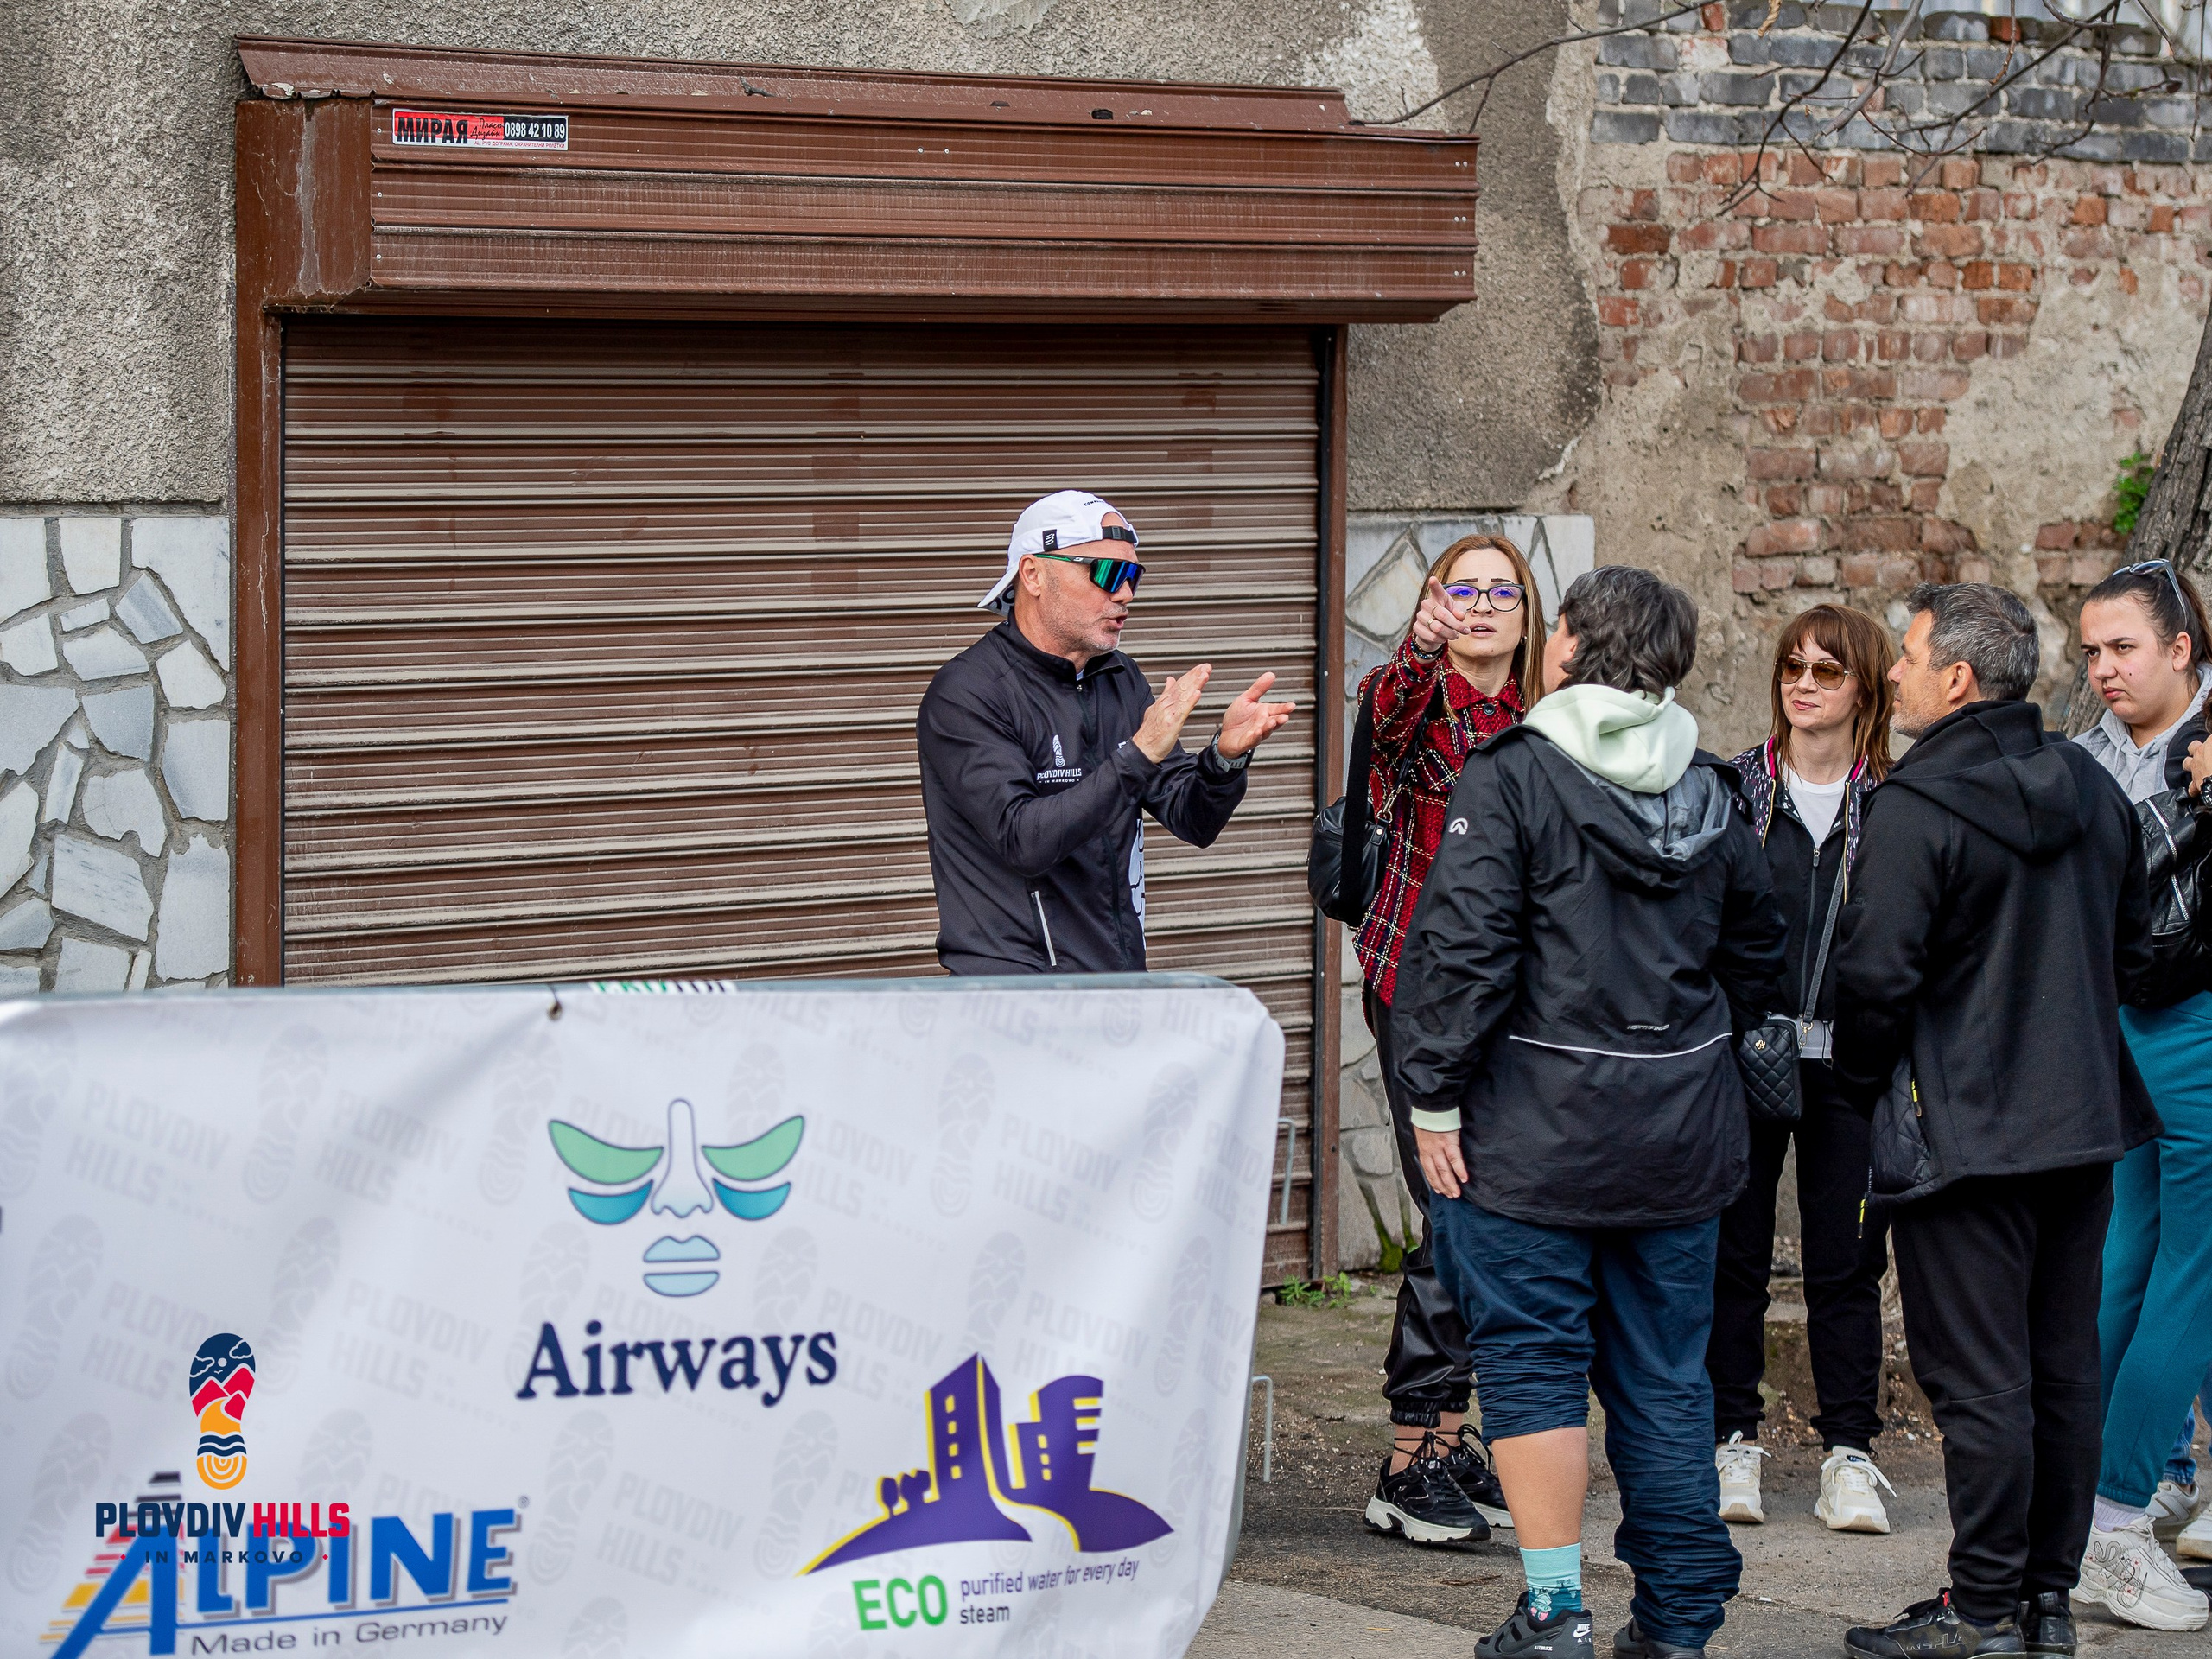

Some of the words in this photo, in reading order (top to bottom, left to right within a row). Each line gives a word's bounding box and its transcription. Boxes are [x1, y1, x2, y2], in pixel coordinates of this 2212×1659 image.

[397, 117, 469, 144] МИРАЯ
[505, 122, 526, 137] 0898
[528, 123, 539, 137] 42
[542, 123, 552, 138] 10
[554, 124, 565, 138] 89
[1065, 768, 1082, 777] HILLS
[516, 1320, 837, 1408] Airways
[960, 1572, 1024, 1602] purified
[1027, 1570, 1063, 1592] water
[1064, 1565, 1082, 1586] for
[1083, 1562, 1116, 1585] every
[1116, 1556, 1140, 1580] day
[852, 1574, 948, 1631] ECO
[959, 1605, 1010, 1625] steam
[191, 1628, 297, 1656] Made
[312, 1625, 342, 1647] in
[355, 1613, 508, 1644] Germany
